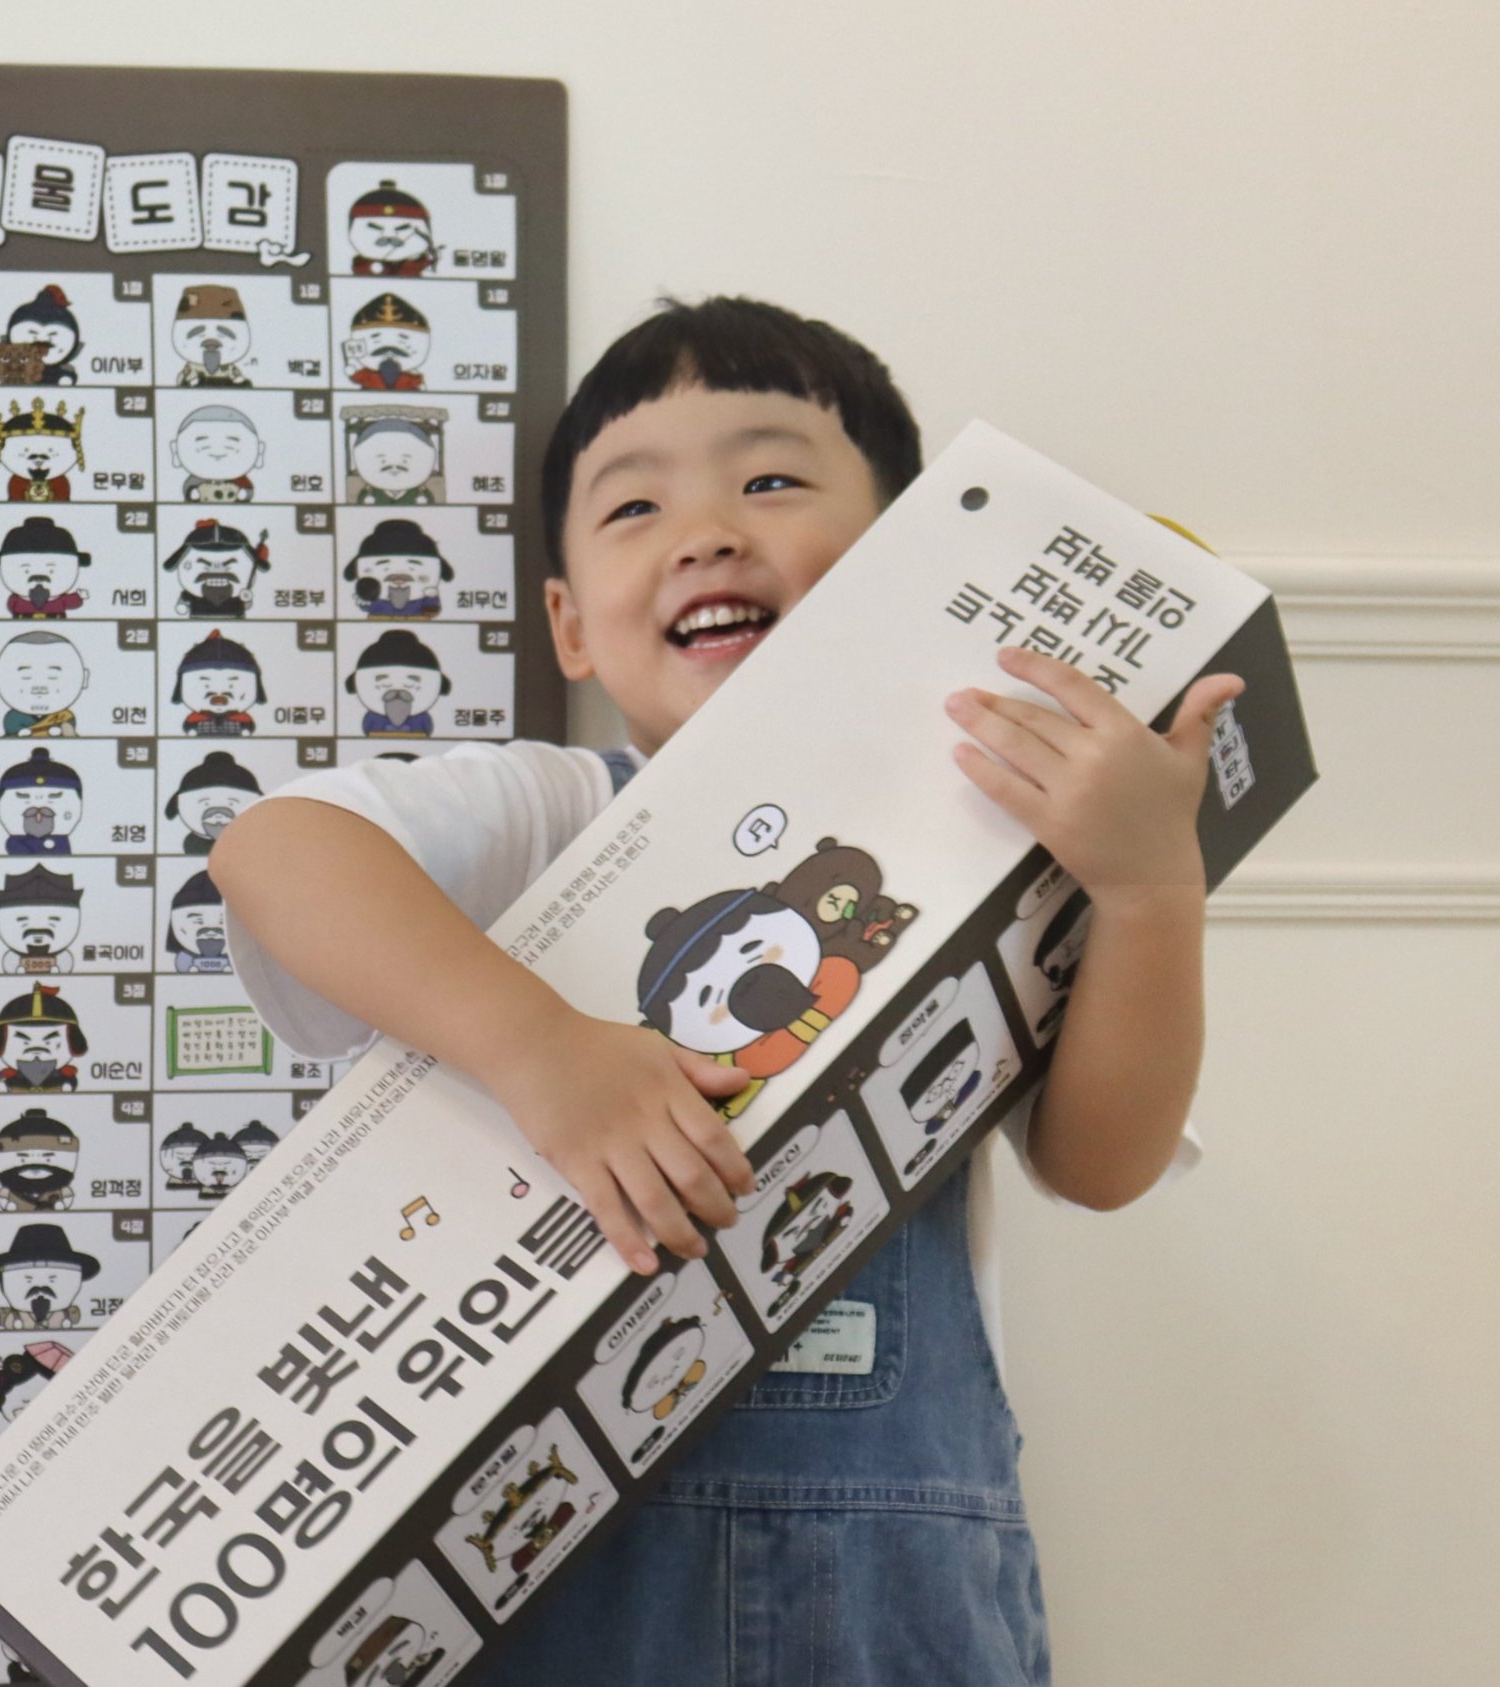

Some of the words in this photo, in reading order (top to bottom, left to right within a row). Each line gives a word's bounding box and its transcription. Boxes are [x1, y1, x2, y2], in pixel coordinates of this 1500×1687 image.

[90, 356, 143, 374] 이사부
[92, 471, 146, 491] 문무왕
[290, 474, 323, 492] 원효
[472, 475, 505, 493] 혜초
[1042, 525, 1118, 589] 벽보
[111, 588, 147, 607] 서희
[274, 589, 325, 608] 정중부
[457, 590, 508, 610] 최무선
[1010, 562, 1086, 628] 벽보
[1117, 568, 1197, 631] 인물
[945, 580, 1027, 646] 노트
[1080, 606, 1157, 671] 가사
[112, 706, 147, 725] 의천
[274, 706, 326, 725] 이종무
[454, 708, 506, 727] 정몽주
[111, 824, 146, 843] 최영
[90, 1061, 143, 1081] 이순신
[90, 1179, 142, 1198] 임꺽정
[59, 1404, 282, 1620] 한국을
[258, 1255, 428, 1415] 빛낸
[130, 1396, 419, 1680] 100명의
[398, 1194, 609, 1400] 위인들
